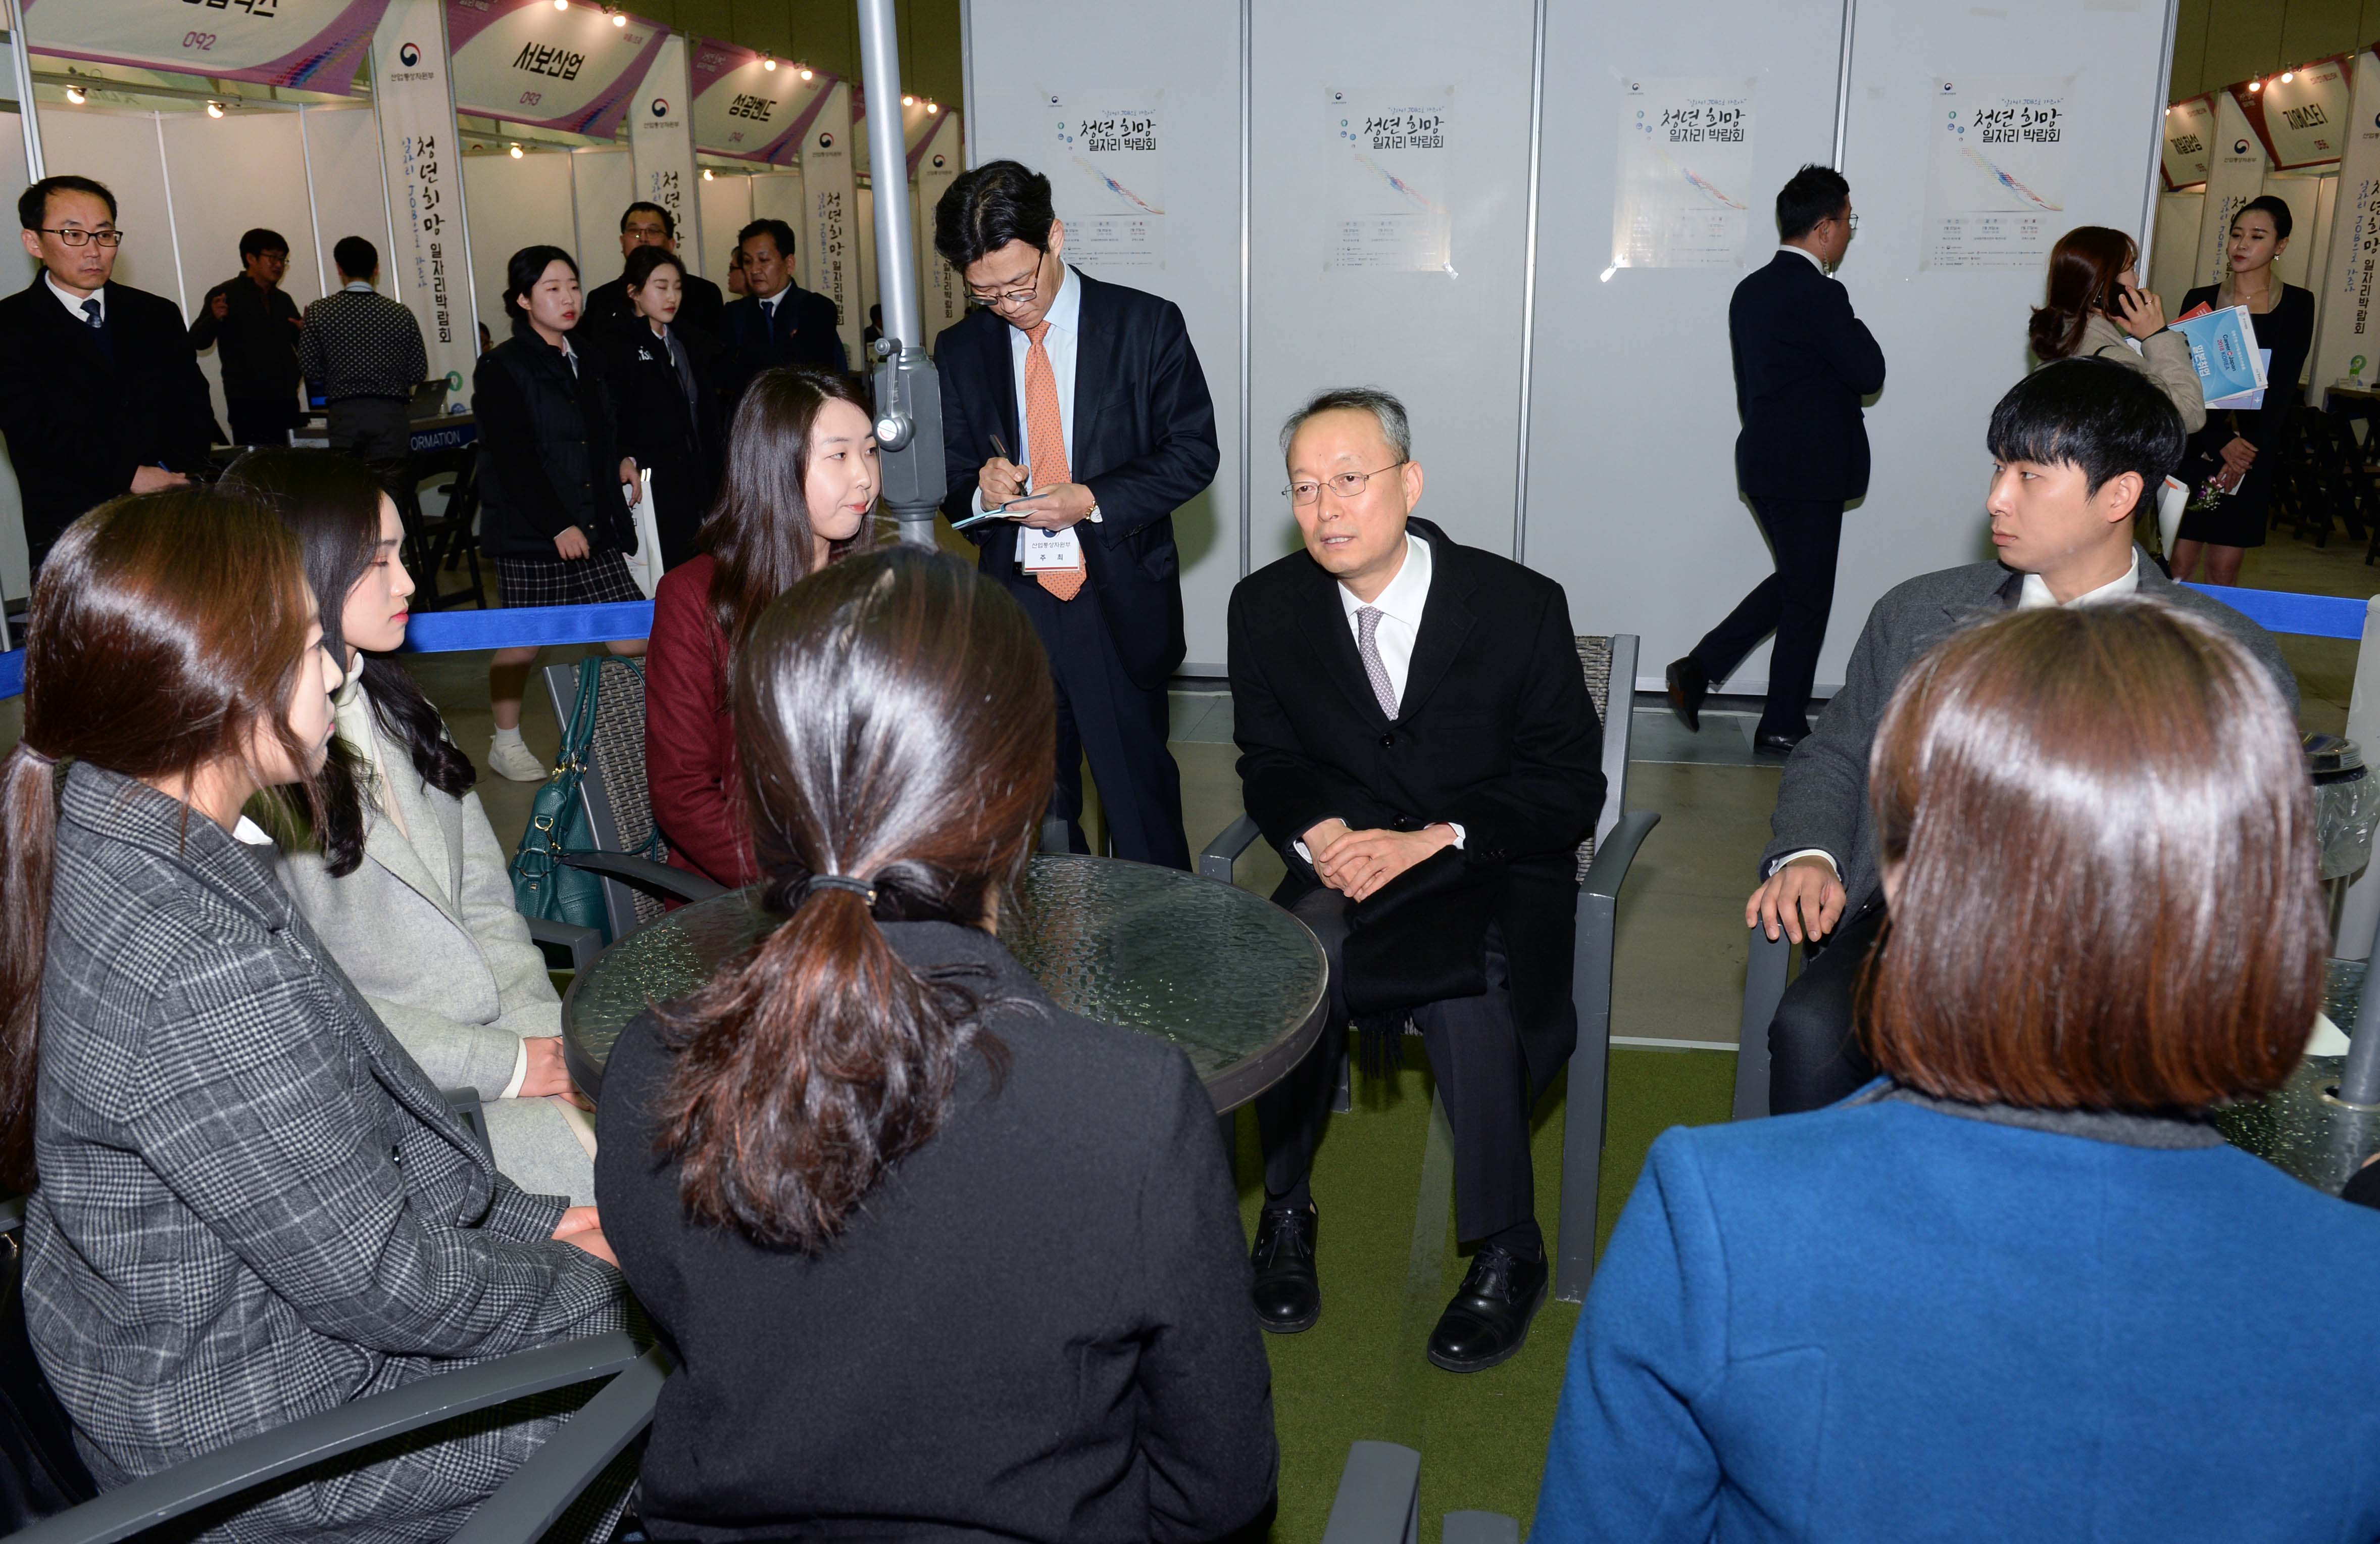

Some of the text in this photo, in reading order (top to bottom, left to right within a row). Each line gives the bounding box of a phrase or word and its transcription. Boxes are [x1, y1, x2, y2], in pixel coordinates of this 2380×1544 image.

[182, 31, 216, 51] 092
[513, 42, 585, 81] 서보산업
[520, 91, 541, 106] 093
[1364, 115, 1445, 136] 청년 희망
[1661, 107, 1746, 128] 청년 희망
[1974, 107, 2062, 129] 청년 희망
[2283, 103, 2328, 130] 지에스티
[1080, 118, 1156, 138] 청년 희망
[1670, 128, 1744, 141] 일자리 박람회
[1982, 128, 2060, 142] 일자리 박람회
[1089, 137, 1156, 151] 일자리 박람회
[1373, 135, 1444, 149] 일자리 박람회
[417, 136, 445, 235] 청년희망
[2222, 334, 2231, 351] Career
[2221, 352, 2229, 370] KOREA
[411, 430, 461, 450] ORMATION
